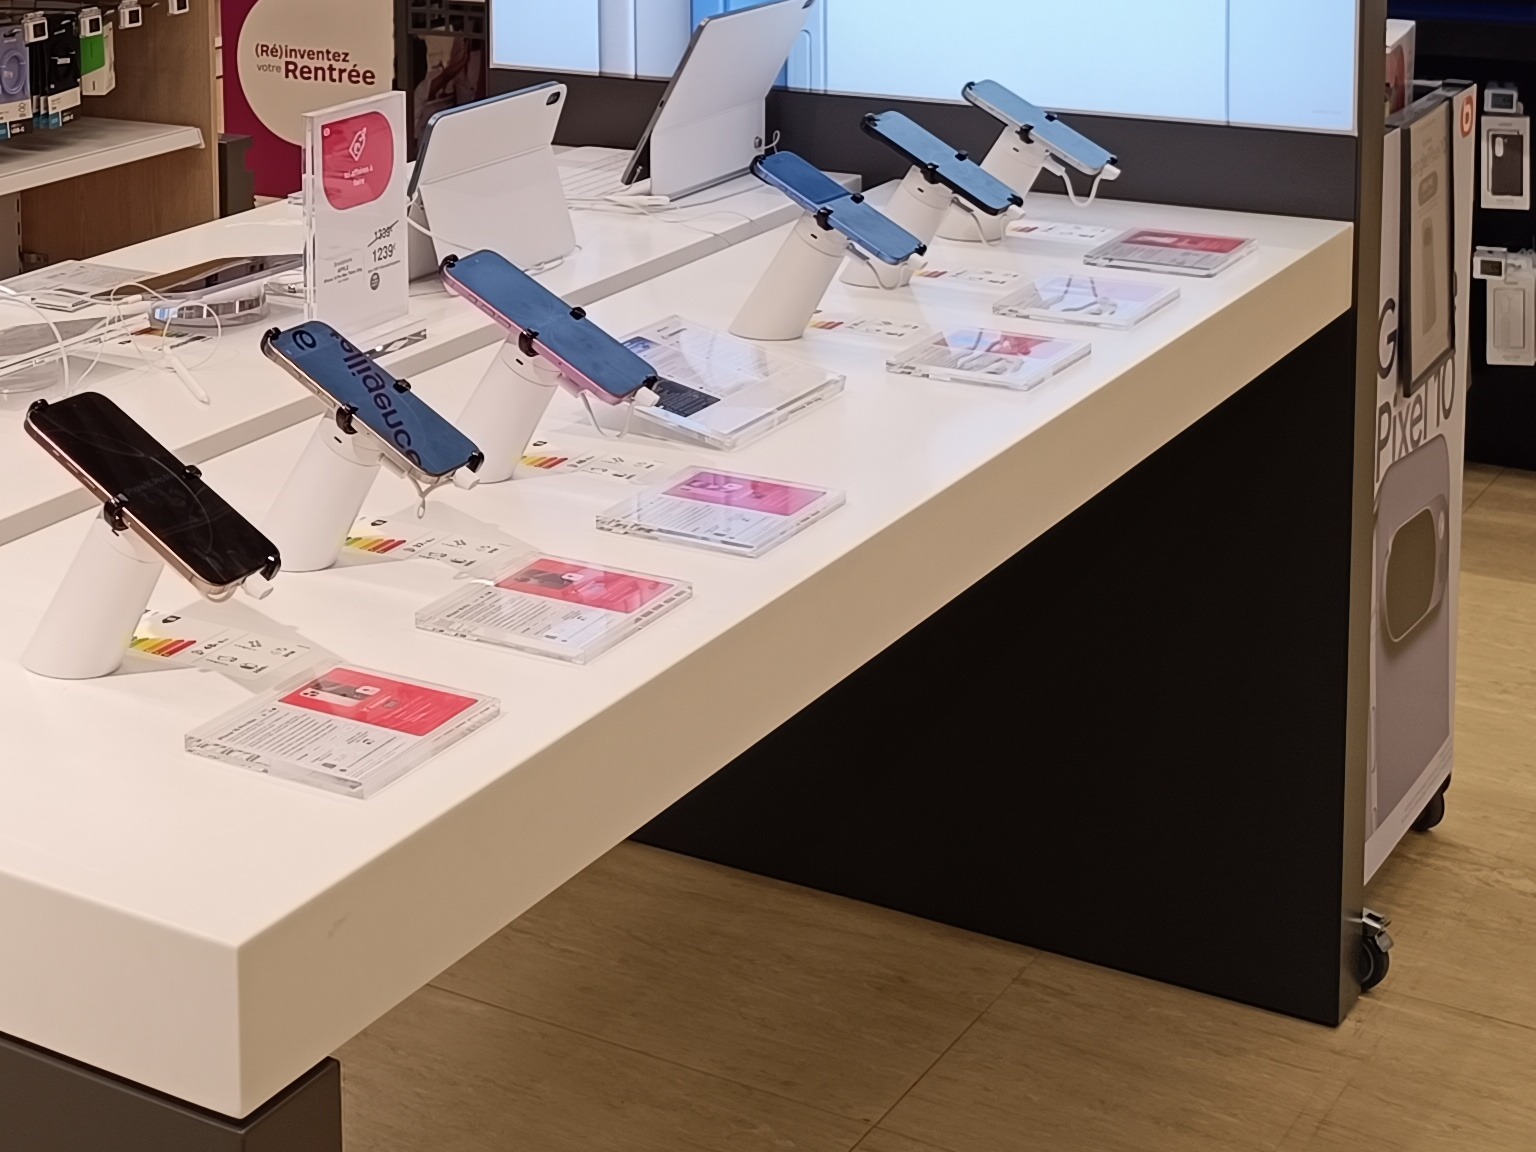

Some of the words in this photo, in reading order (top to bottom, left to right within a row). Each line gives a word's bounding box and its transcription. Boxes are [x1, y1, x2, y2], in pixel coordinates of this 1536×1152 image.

[255, 43, 350, 63] (Ré)inventez
[256, 63, 282, 73] votre
[284, 60, 376, 86] Rentrée
[1375, 378, 1427, 482] Pixel
[1433, 358, 1456, 430] 10
